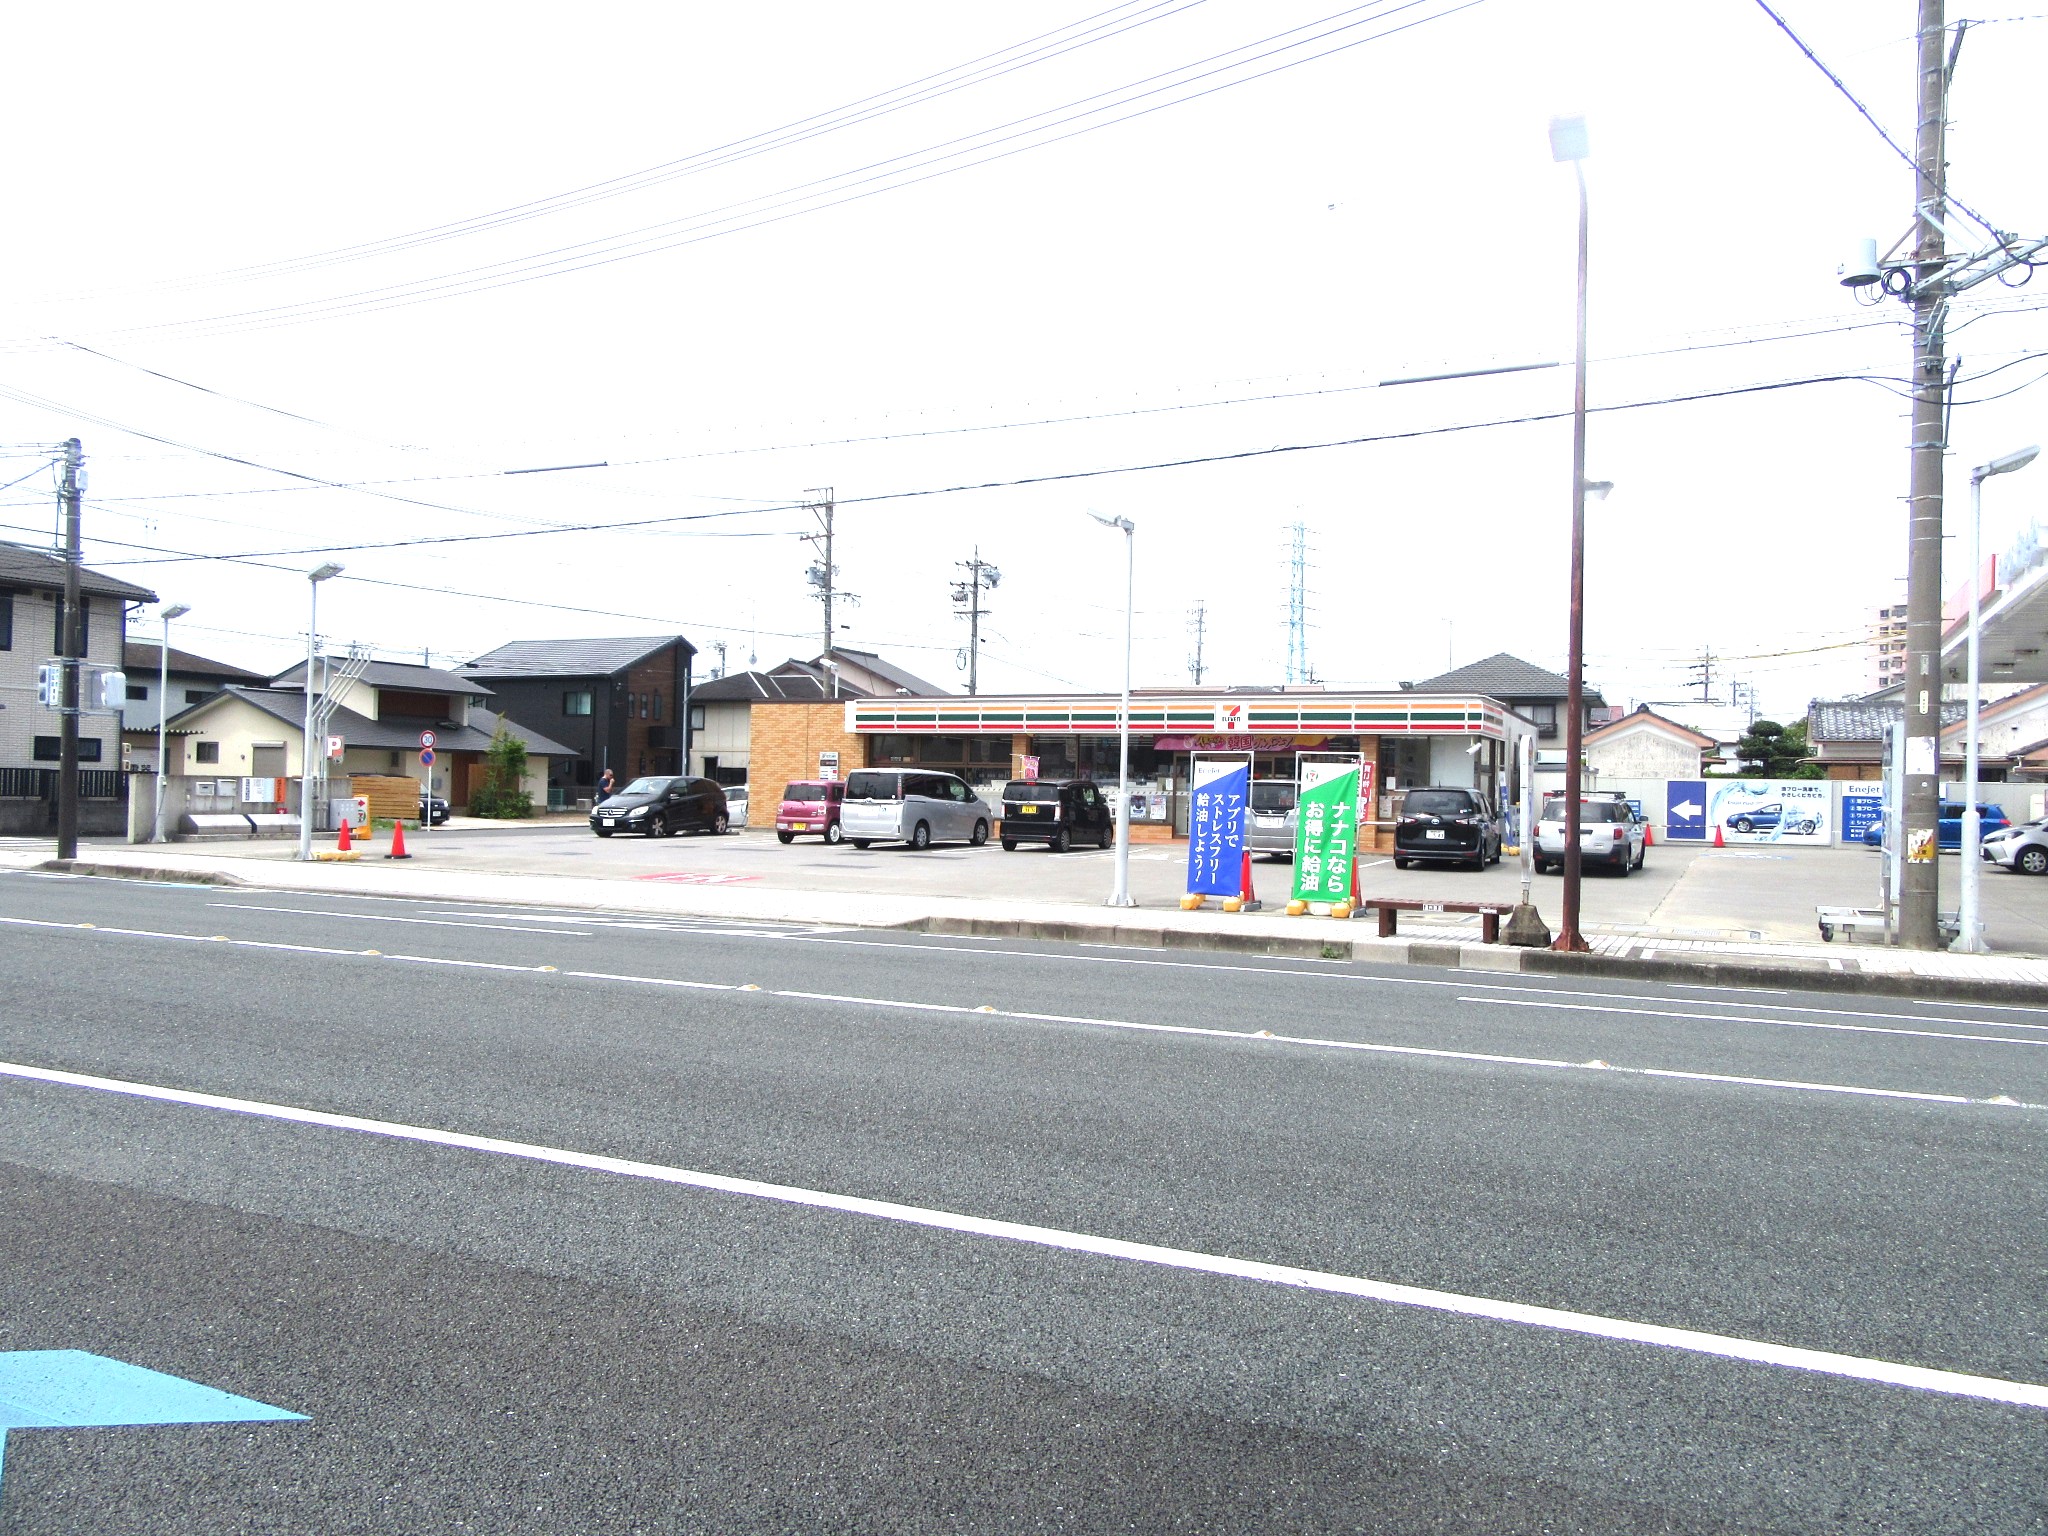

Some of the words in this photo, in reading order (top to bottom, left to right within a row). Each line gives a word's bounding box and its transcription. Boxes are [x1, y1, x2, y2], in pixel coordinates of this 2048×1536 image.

[327, 738, 341, 756] P
[423, 736, 433, 744] 30
[1209, 794, 1224, 885] ストレスフリー
[1225, 794, 1241, 848] アプリで
[1300, 801, 1325, 892] お得に給油
[1327, 801, 1351, 893] ナナコなら
